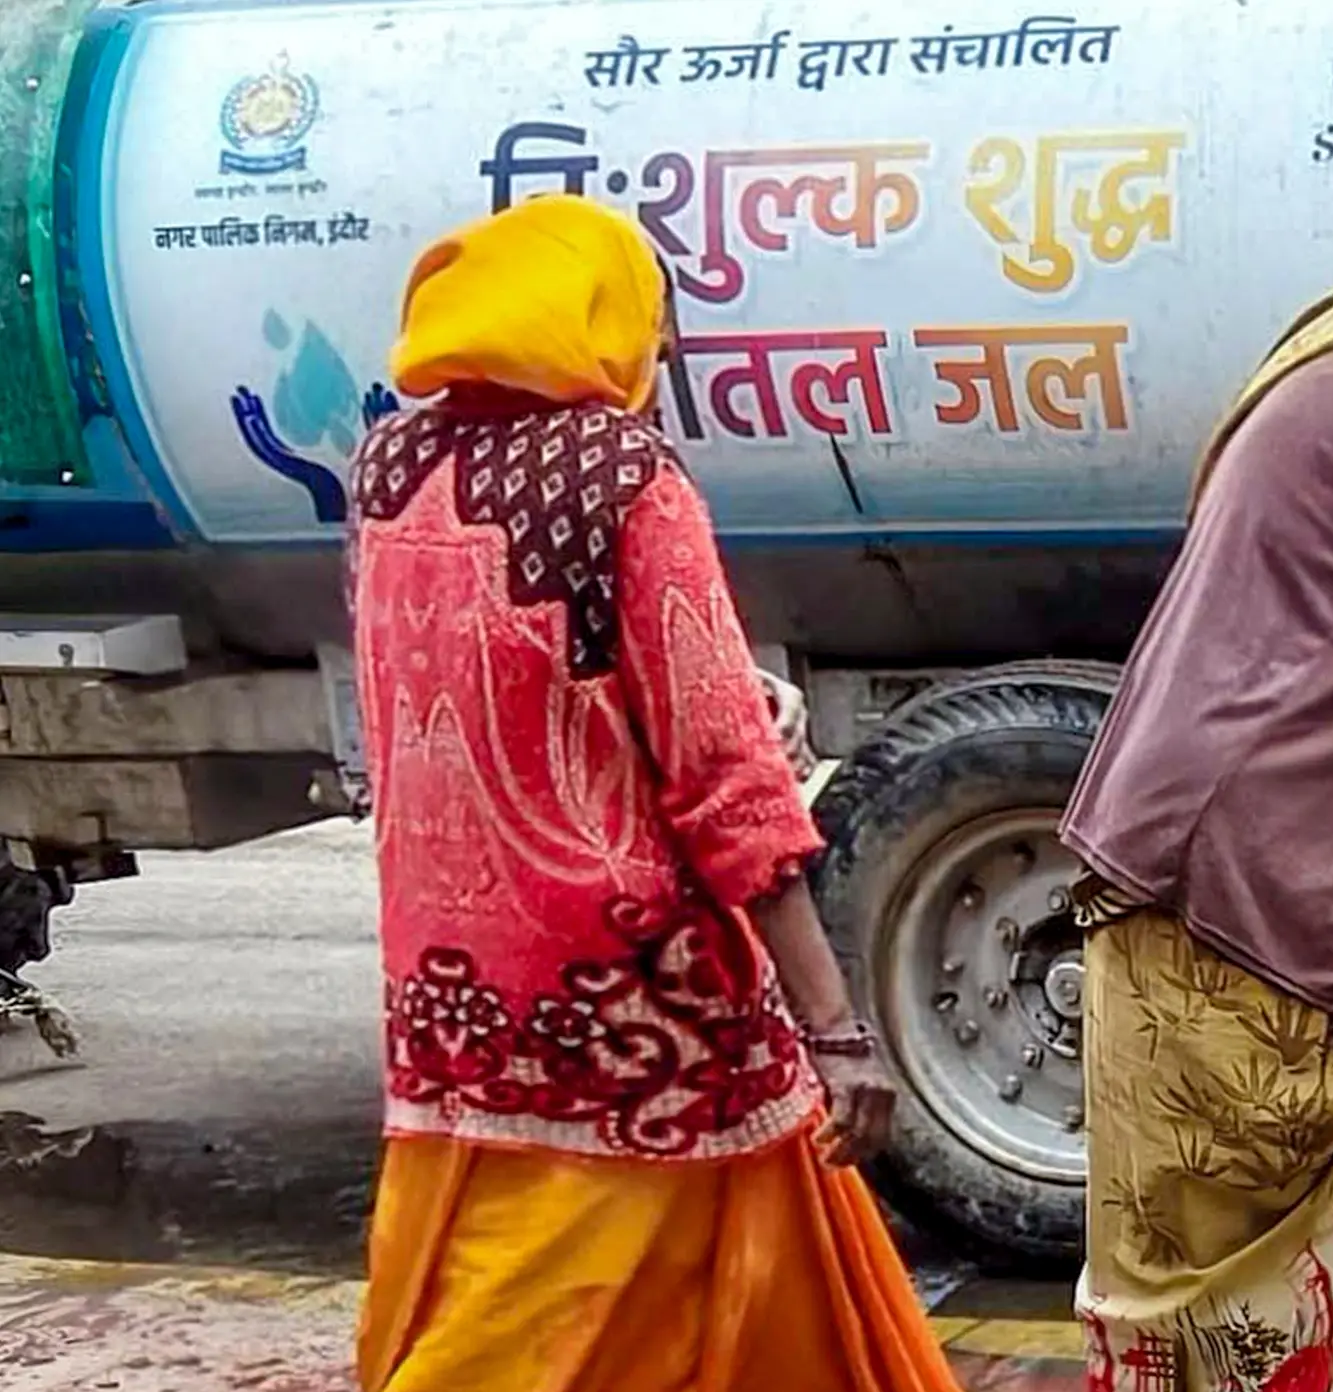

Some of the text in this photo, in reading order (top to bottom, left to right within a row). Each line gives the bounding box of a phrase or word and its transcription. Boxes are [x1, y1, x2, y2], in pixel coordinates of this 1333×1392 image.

[583, 16, 1120, 91] सौर ऊर्जा द्वारा संचालित
[153, 226, 197, 249] नगर
[201, 217, 260, 247] पालिक
[963, 128, 1185, 293] शुद्ध
[914, 326, 1128, 433] जल
